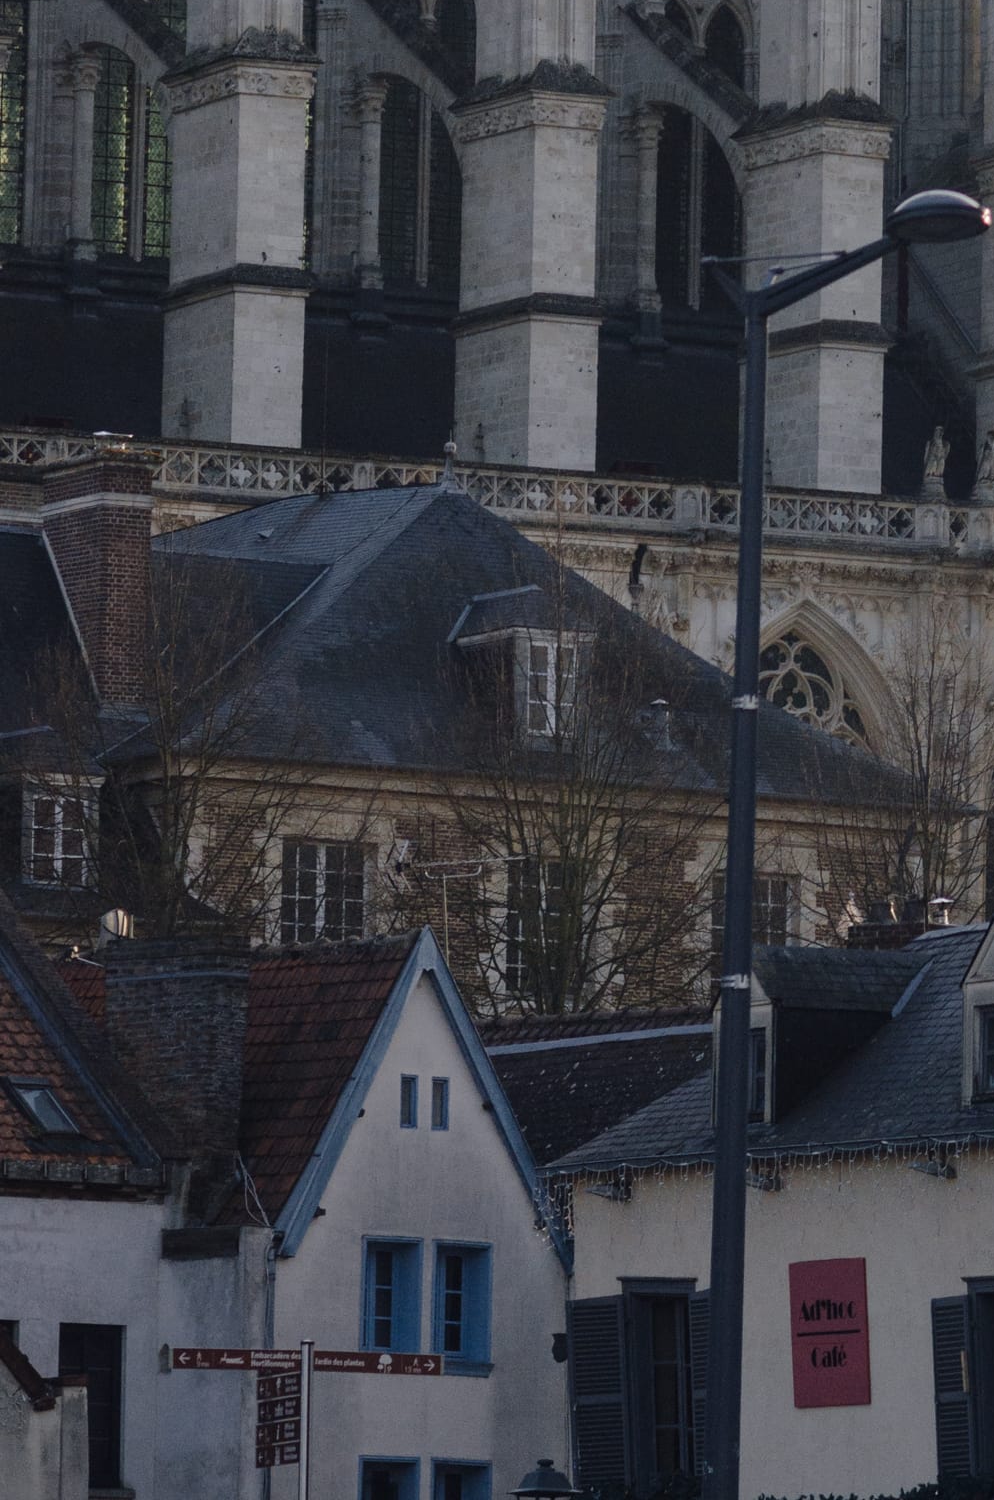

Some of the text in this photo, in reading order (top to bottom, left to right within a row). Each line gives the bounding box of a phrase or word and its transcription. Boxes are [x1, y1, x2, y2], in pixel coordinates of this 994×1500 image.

[314, 1357, 365, 1367] Jardin des plantes
[811, 1344, 847, 1368] Café
